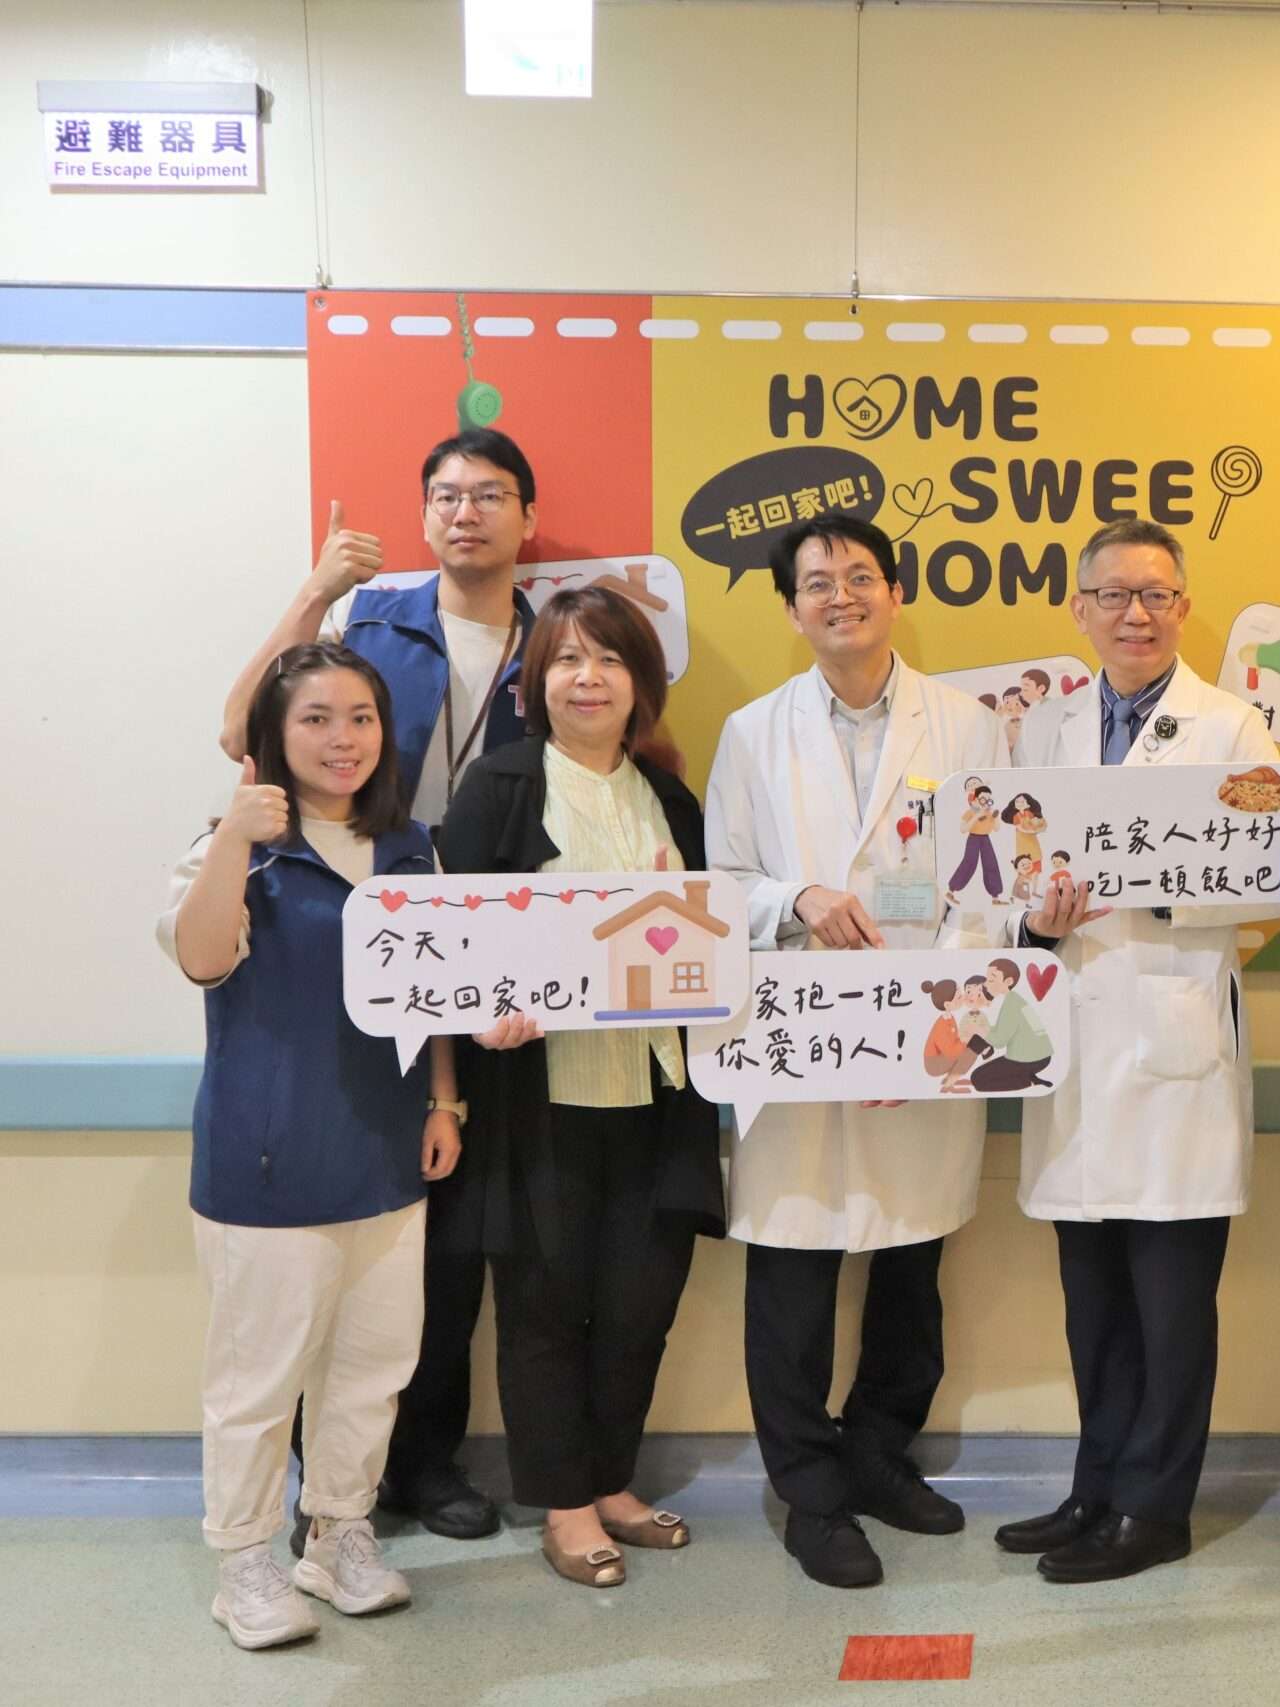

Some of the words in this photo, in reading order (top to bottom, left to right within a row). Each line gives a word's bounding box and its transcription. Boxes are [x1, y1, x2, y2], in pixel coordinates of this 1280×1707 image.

[56, 119, 247, 154] 避難器具
[54, 161, 86, 176] Fire
[91, 162, 153, 180] Escape
[158, 162, 249, 180] Equipment
[695, 474, 873, 540] 一起回家吧！
[1086, 864, 1280, 898] 吃一頓飯吧
[367, 976, 590, 1019] 一起回家吧！
[755, 976, 913, 1021] 家抱一抱
[714, 1027, 906, 1079] 你愛的人！
